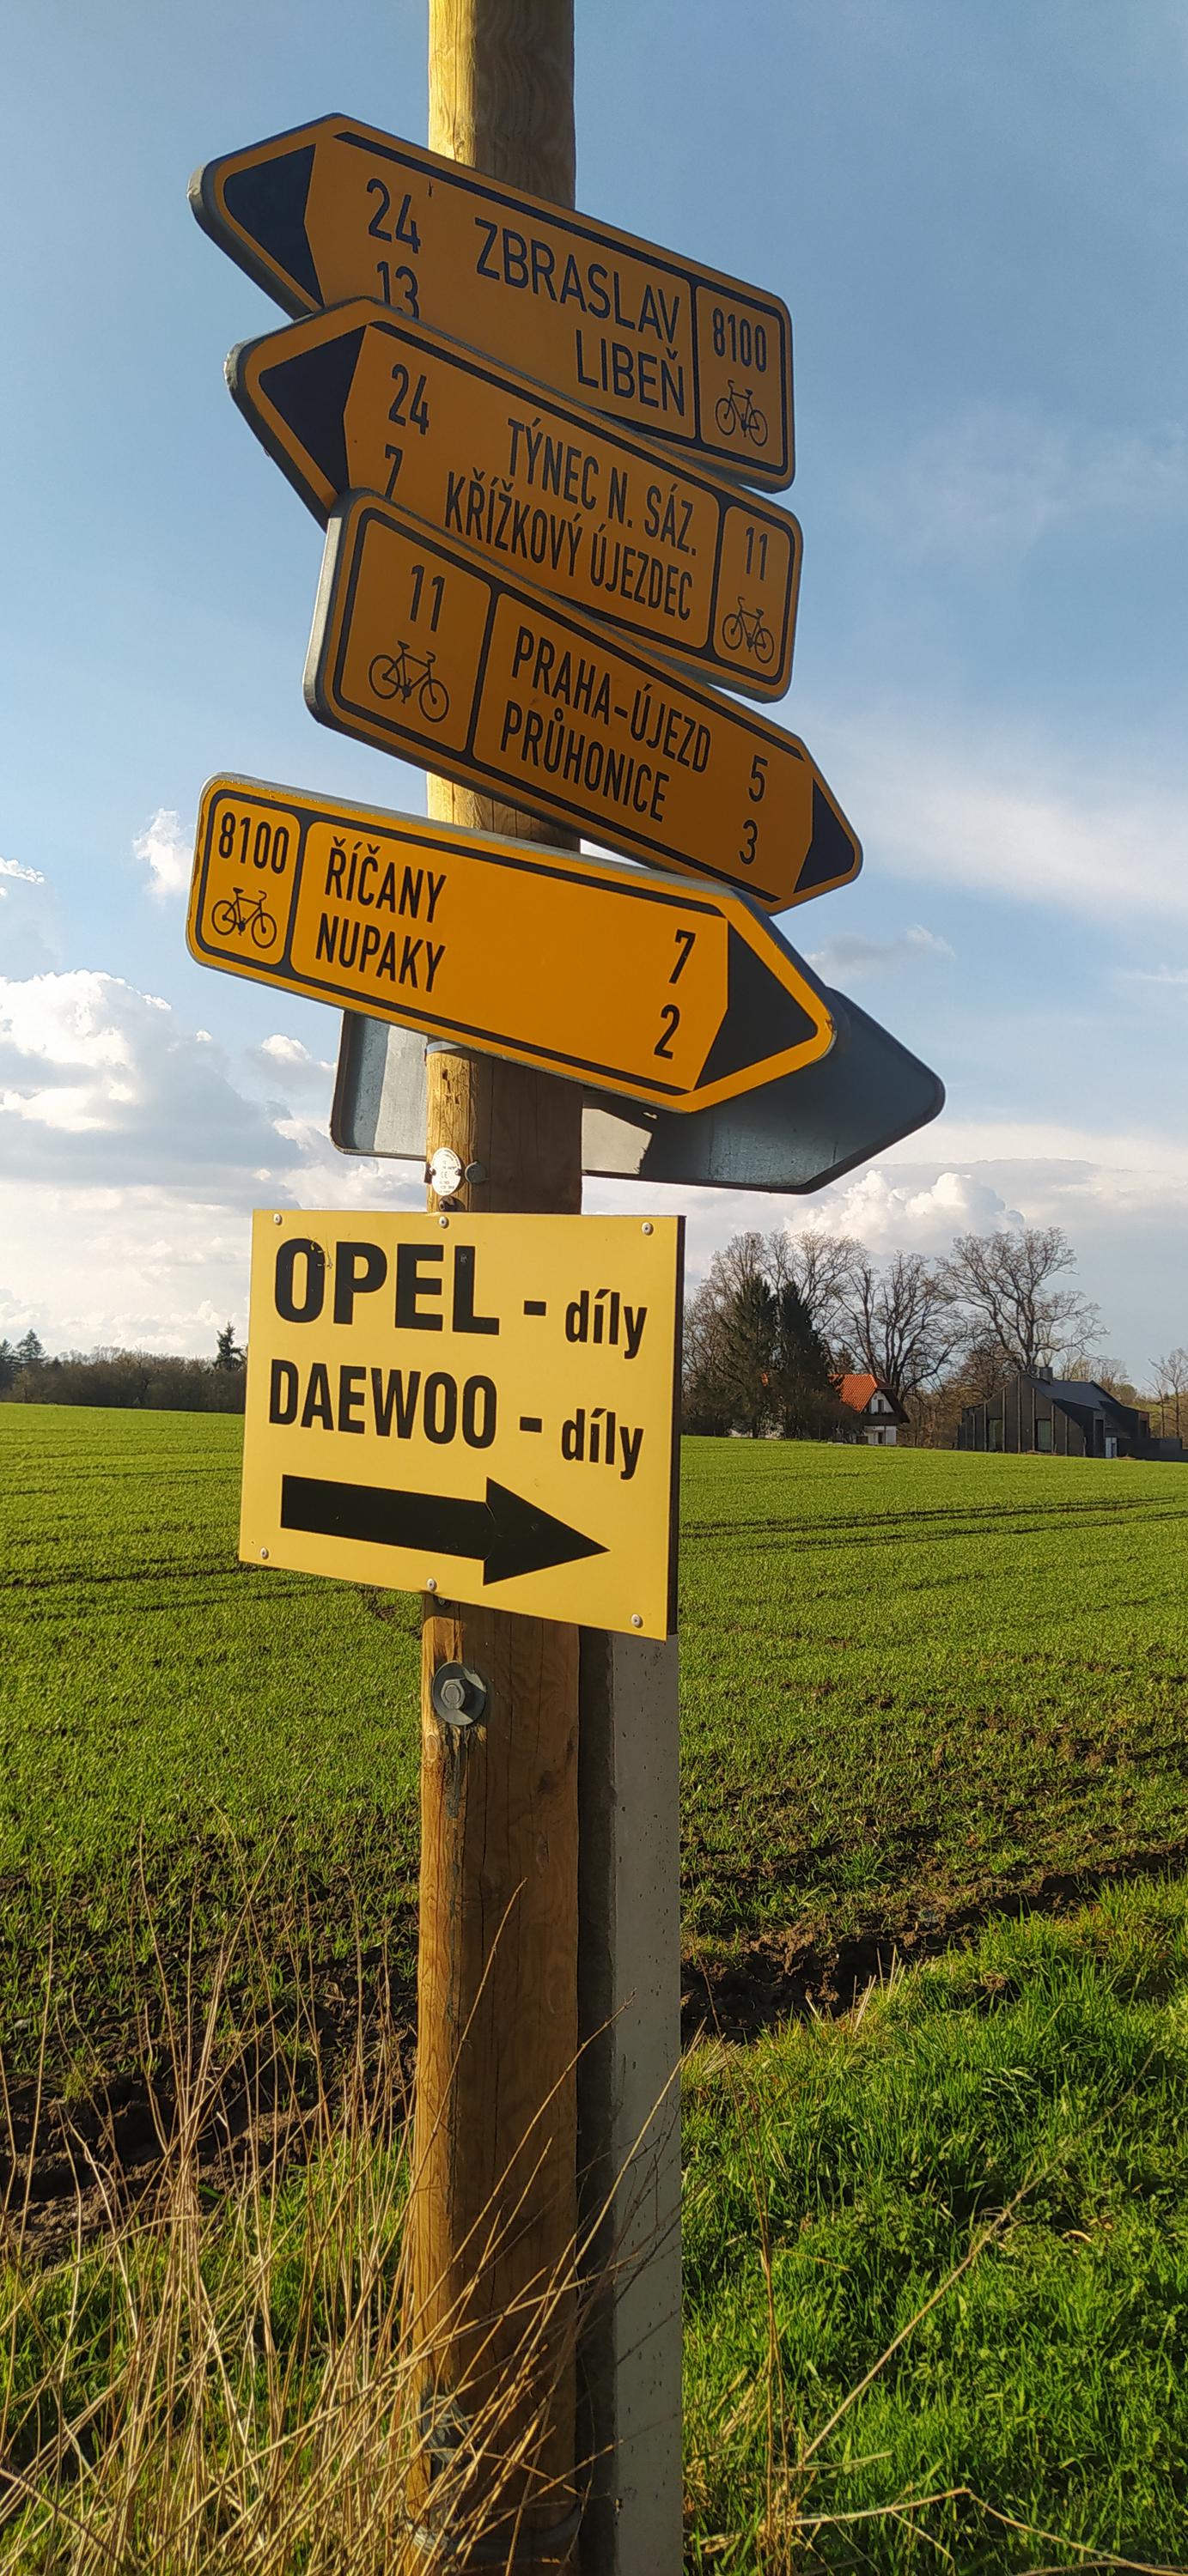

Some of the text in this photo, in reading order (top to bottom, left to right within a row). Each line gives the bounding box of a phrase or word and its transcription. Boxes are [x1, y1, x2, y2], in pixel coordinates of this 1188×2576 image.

[367, 179, 680, 343] 24 ZBRASLAV
[377, 261, 685, 416] 13 LIBEŇ
[712, 307, 768, 373] 8100
[388, 363, 696, 555] 24 TÝNEC N. SÁZ.
[385, 445, 691, 621] 7 KŘÍŽKOVÝ ÚJEZDEC
[411, 564, 445, 632] 11
[745, 526, 768, 581] 11
[501, 702, 758, 864] PRŮHONICE 3
[513, 627, 768, 802] PRAHA-ÚJEZD 5
[219, 812, 289, 875] 8100
[325, 836, 695, 984] ŘÍČANY 7
[315, 913, 679, 1060] NUPAKY 2
[275, 1238, 647, 1359] OPEL - díly
[269, 1358, 643, 1479] DAEWOO - díly
